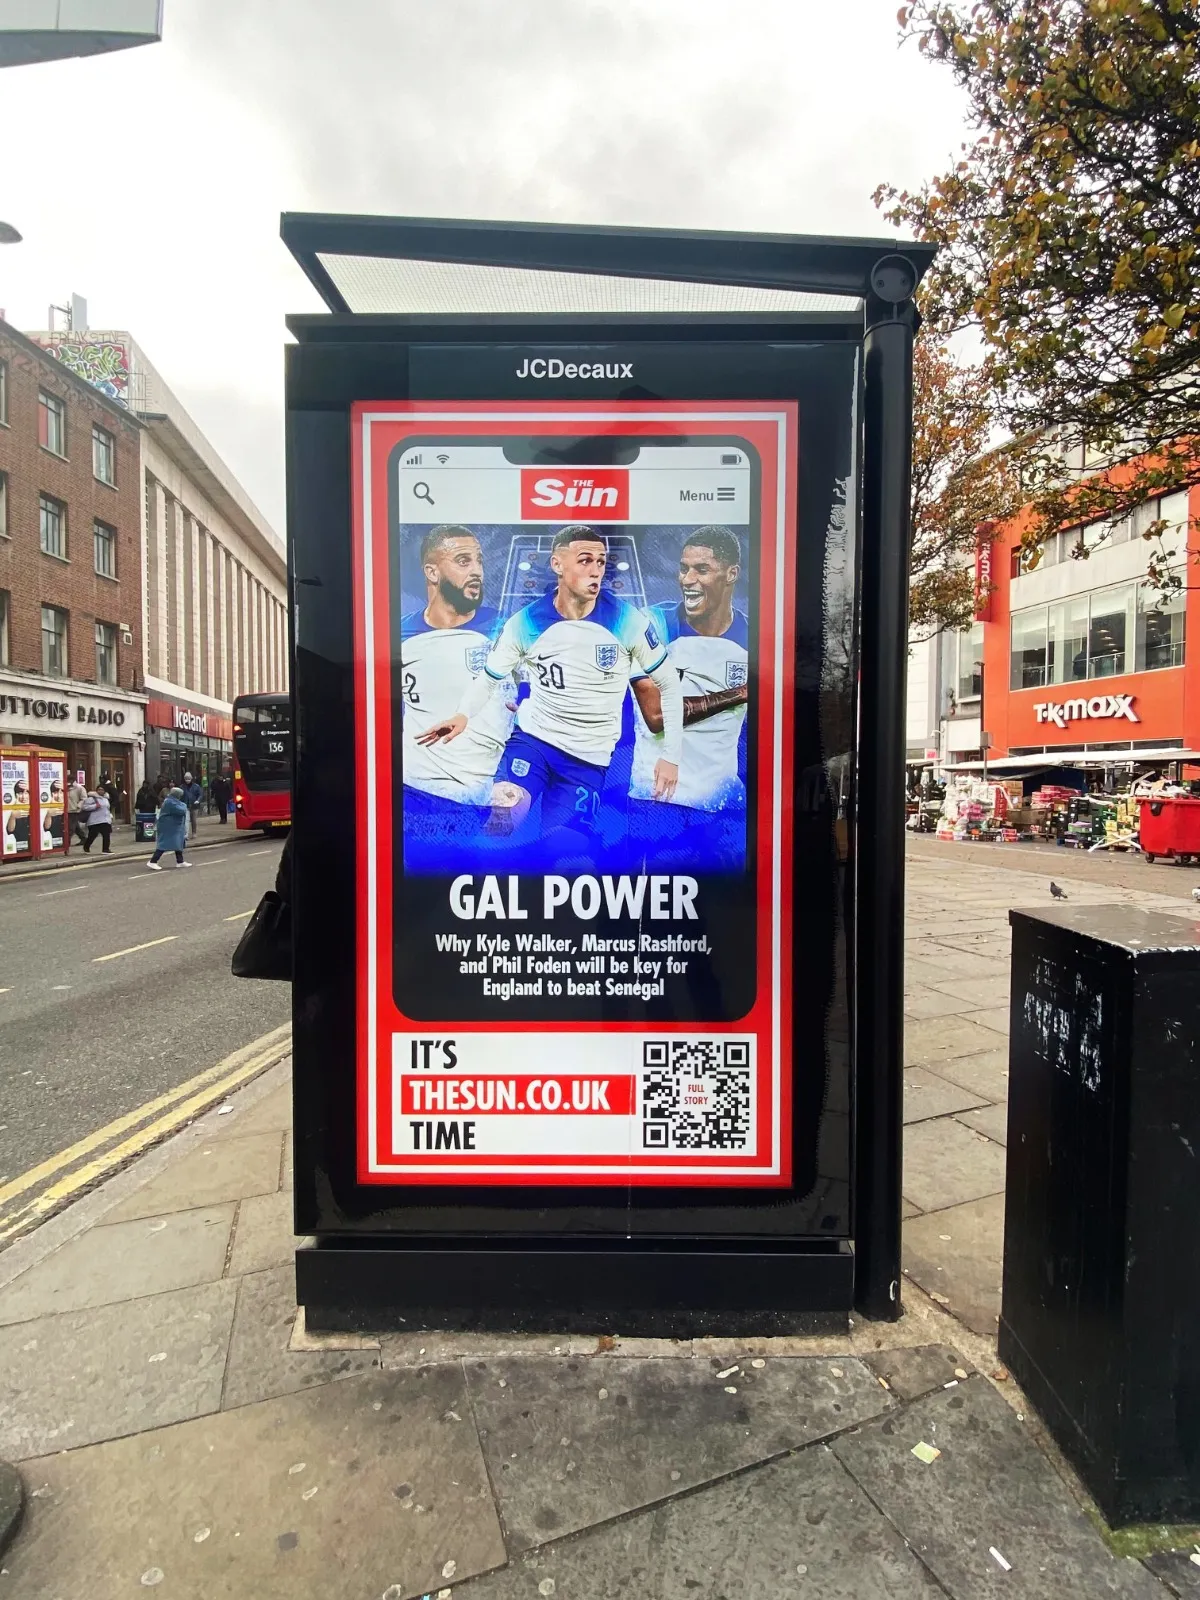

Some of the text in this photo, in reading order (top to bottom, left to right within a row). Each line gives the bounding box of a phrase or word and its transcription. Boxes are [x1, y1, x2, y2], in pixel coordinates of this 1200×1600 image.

[516, 358, 633, 379] JCDecaux
[530, 478, 619, 507] Sun
[573, 479, 594, 487] THE
[679, 489, 714, 502] Menu
[405, 672, 420, 703] 2
[536, 663, 566, 689] 20
[77, 705, 125, 727] RADIO
[173, 706, 207, 735] Iceland
[269, 742, 284, 753] 136
[450, 874, 699, 920] GAL POWER
[435, 933, 713, 957] Why Kyle Walker, Marcus Rashford,
[459, 956, 689, 979] and Phil Foden will be key for
[483, 978, 665, 1001] England to beat Senegal
[411, 1040, 458, 1069] IT’S
[409, 1080, 611, 1111] THESUN.CO.UK
[687, 1084, 705, 1093] FULL
[684, 1096, 709, 1105] STORY
[409, 1121, 476, 1150] TIME
